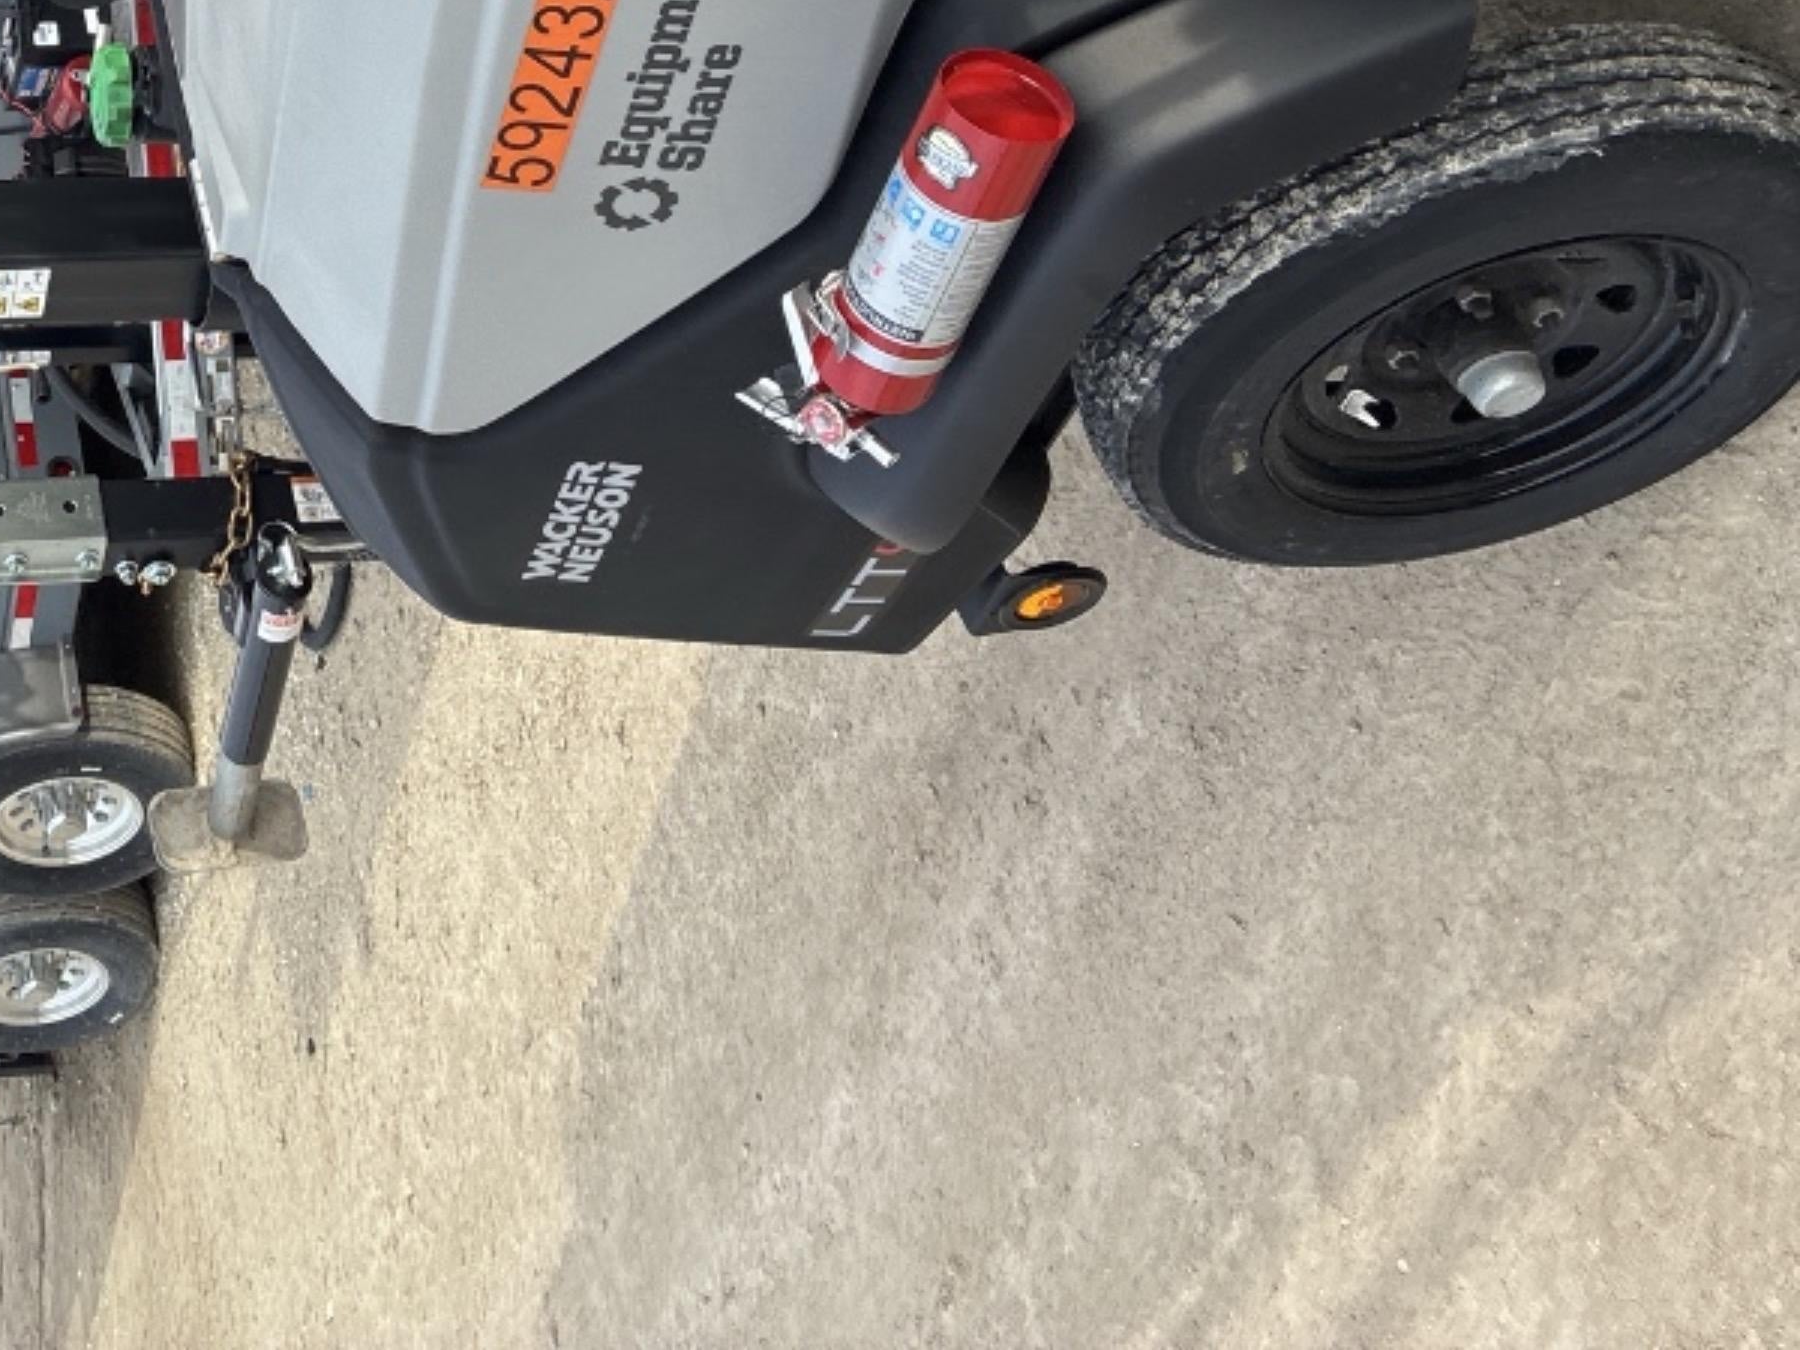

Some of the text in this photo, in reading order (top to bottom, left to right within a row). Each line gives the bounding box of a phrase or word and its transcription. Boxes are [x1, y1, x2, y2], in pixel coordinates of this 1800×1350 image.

[656, 43, 743, 172] Share
[521, 460, 607, 580] WACKER
[557, 460, 643, 583] NEUSON
